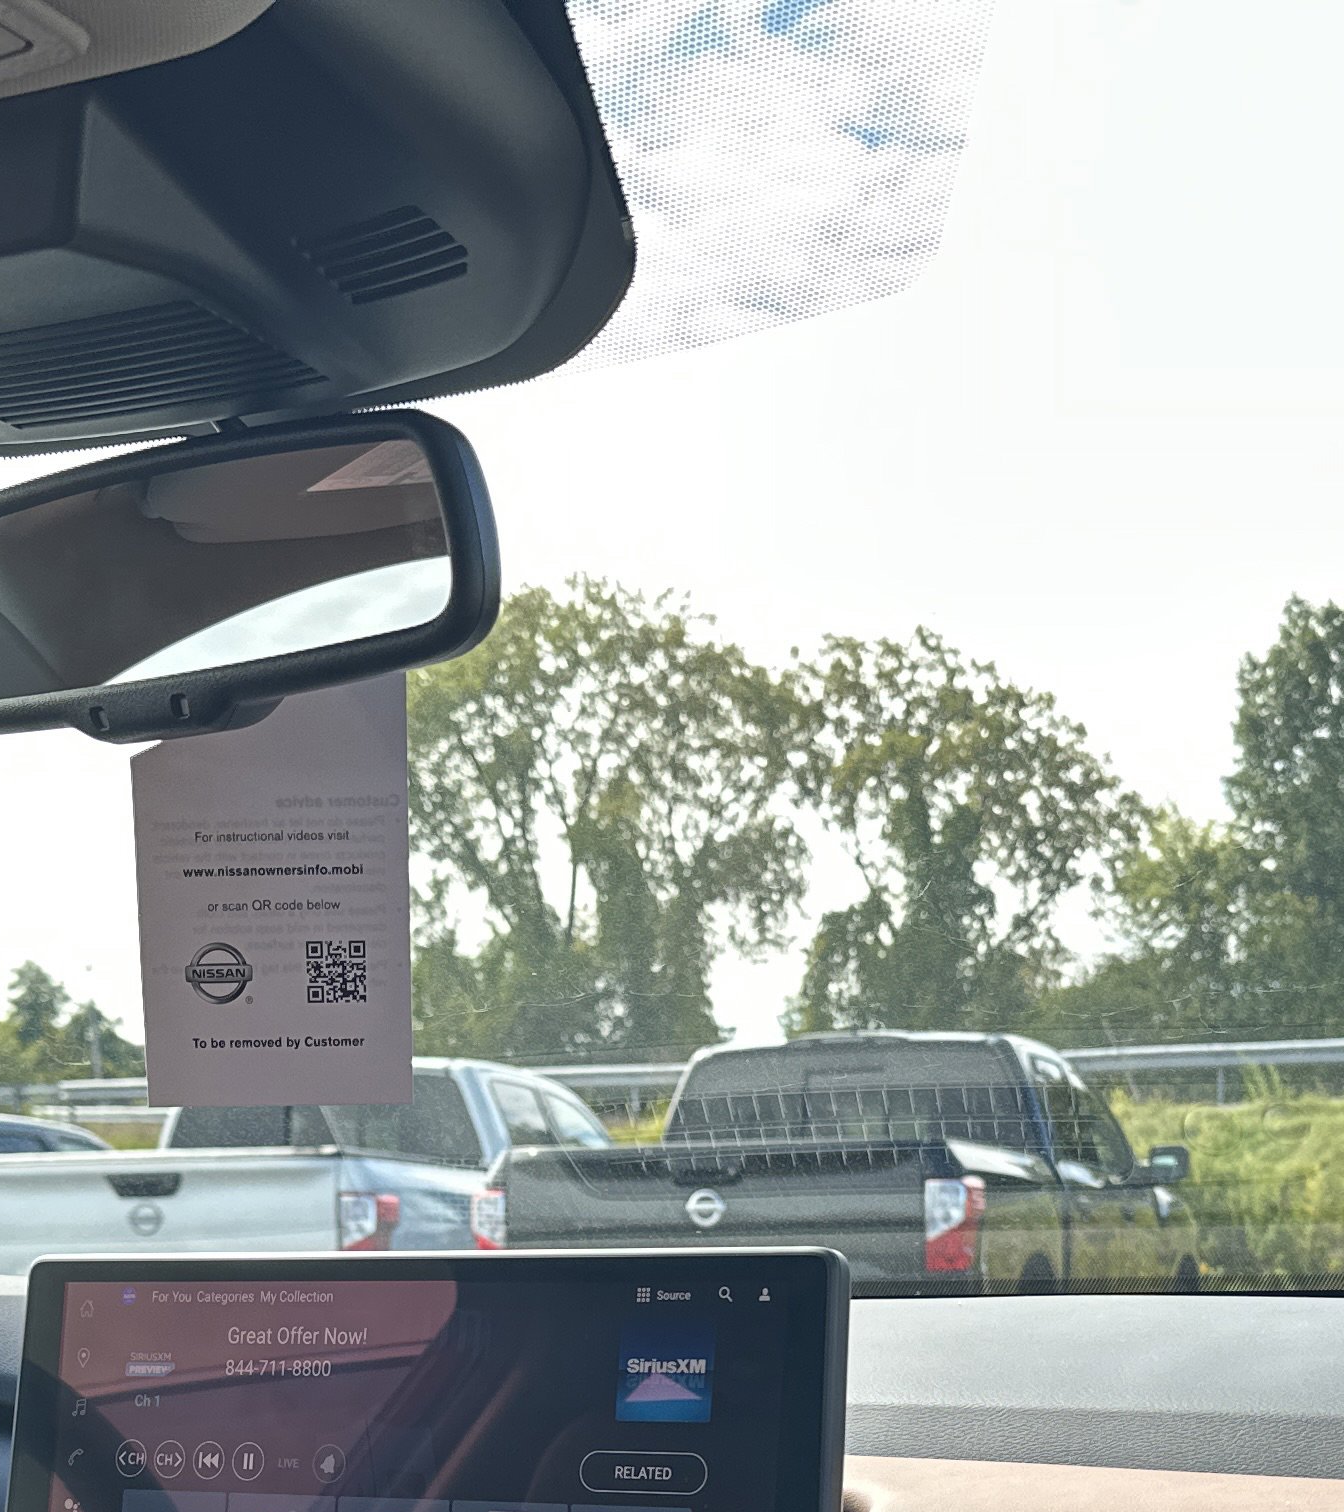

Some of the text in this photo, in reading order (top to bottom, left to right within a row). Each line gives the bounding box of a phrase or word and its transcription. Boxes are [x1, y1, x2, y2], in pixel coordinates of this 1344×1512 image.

[195, 830, 349, 843] For instructional videos visit
[183, 864, 363, 877] www.nissanownersinfo.mobi
[208, 899, 340, 911] or scan QR code below
[192, 969, 246, 978] NISSAN
[193, 1037, 365, 1049] To be removed by Customer
[152, 1291, 333, 1305] For You Categories My Collection
[656, 1290, 691, 1301] Source
[228, 1327, 367, 1345] Great Offer Now!
[225, 1360, 331, 1376] 844-711-8800
[627, 1358, 706, 1374] SiriusXM
[135, 1395, 160, 1407] Ch 1
[278, 1458, 299, 1468] LIVE
[615, 1466, 672, 1480] RELATED
